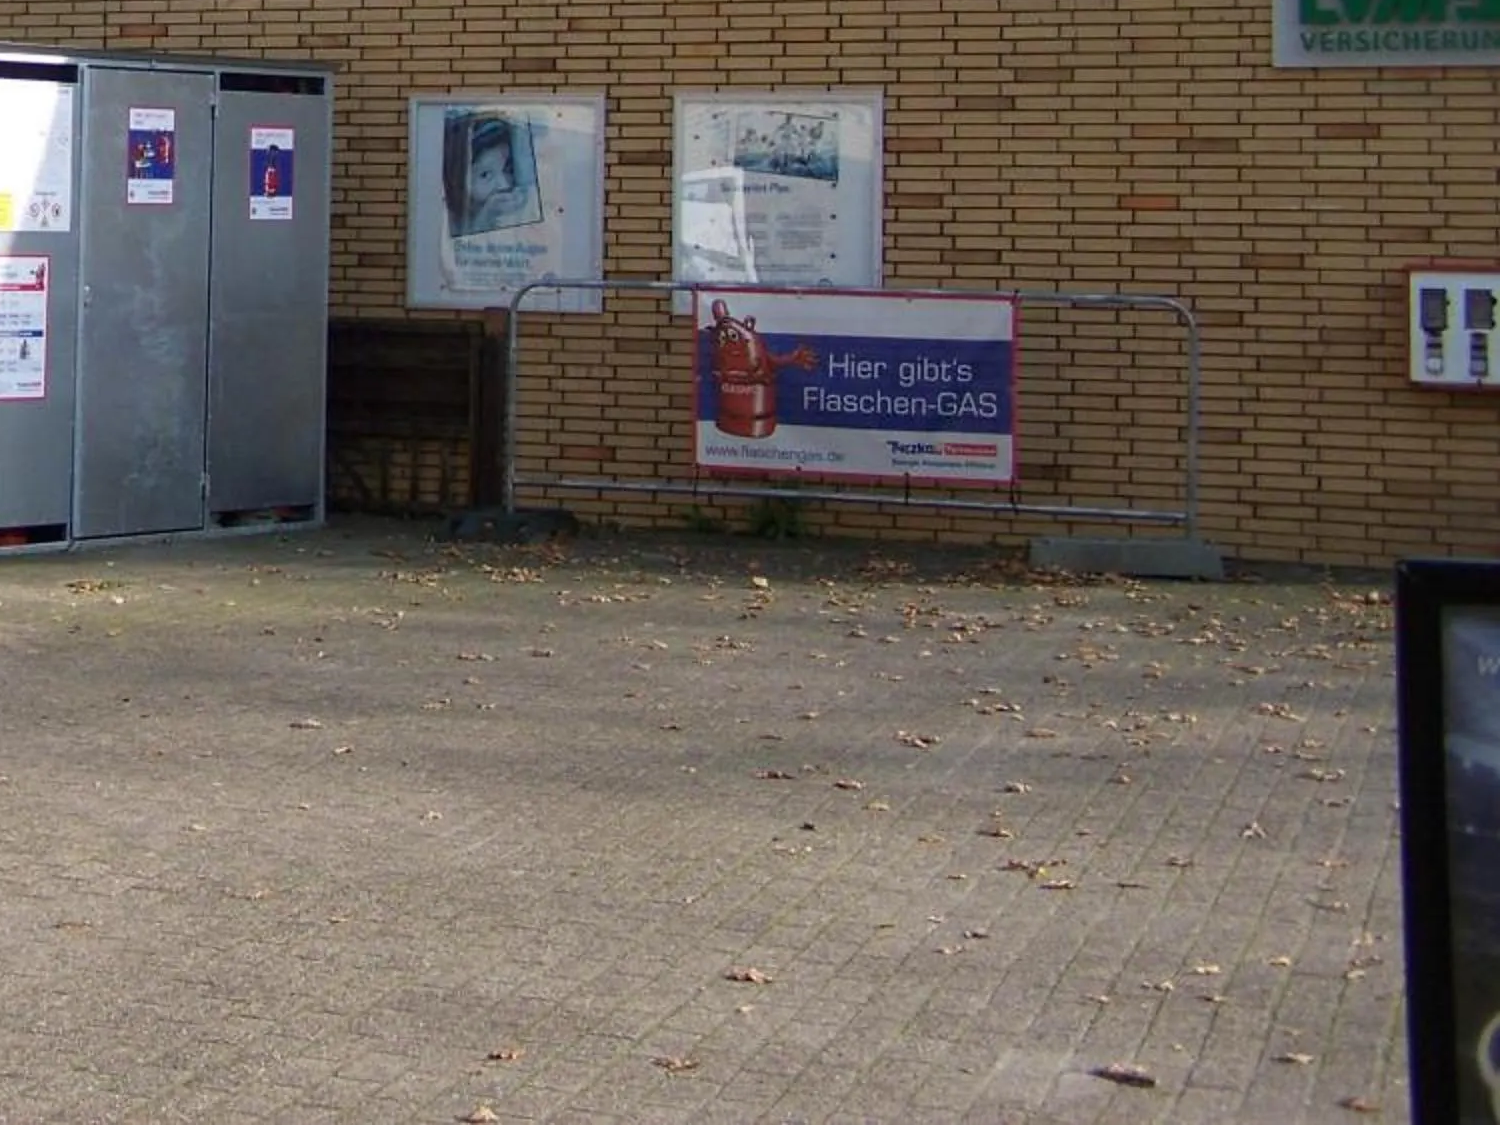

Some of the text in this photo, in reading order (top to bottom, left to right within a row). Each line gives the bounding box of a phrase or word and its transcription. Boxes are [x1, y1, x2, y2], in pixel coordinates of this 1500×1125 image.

[828, 352, 973, 387] Hier gibt's
[803, 386, 998, 418] Flaschen-GAS
